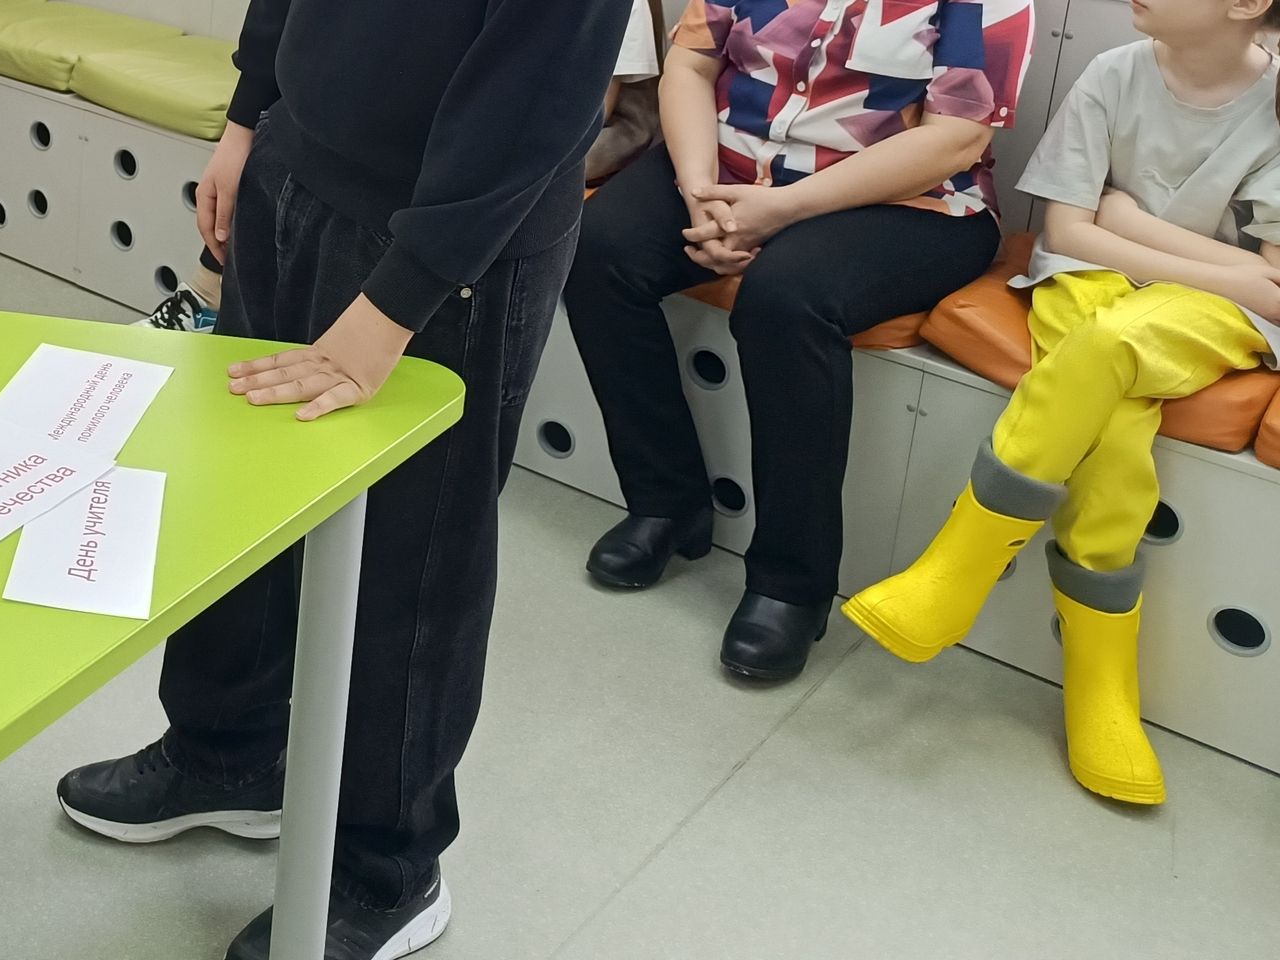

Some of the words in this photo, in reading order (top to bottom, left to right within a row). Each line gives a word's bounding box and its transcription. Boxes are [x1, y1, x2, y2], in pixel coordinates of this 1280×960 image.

[94, 362, 113, 381] день
[77, 404, 110, 443] пожилого
[104, 372, 133, 403] человека
[67, 540, 99, 582] День
[83, 480, 112, 537] учителя
